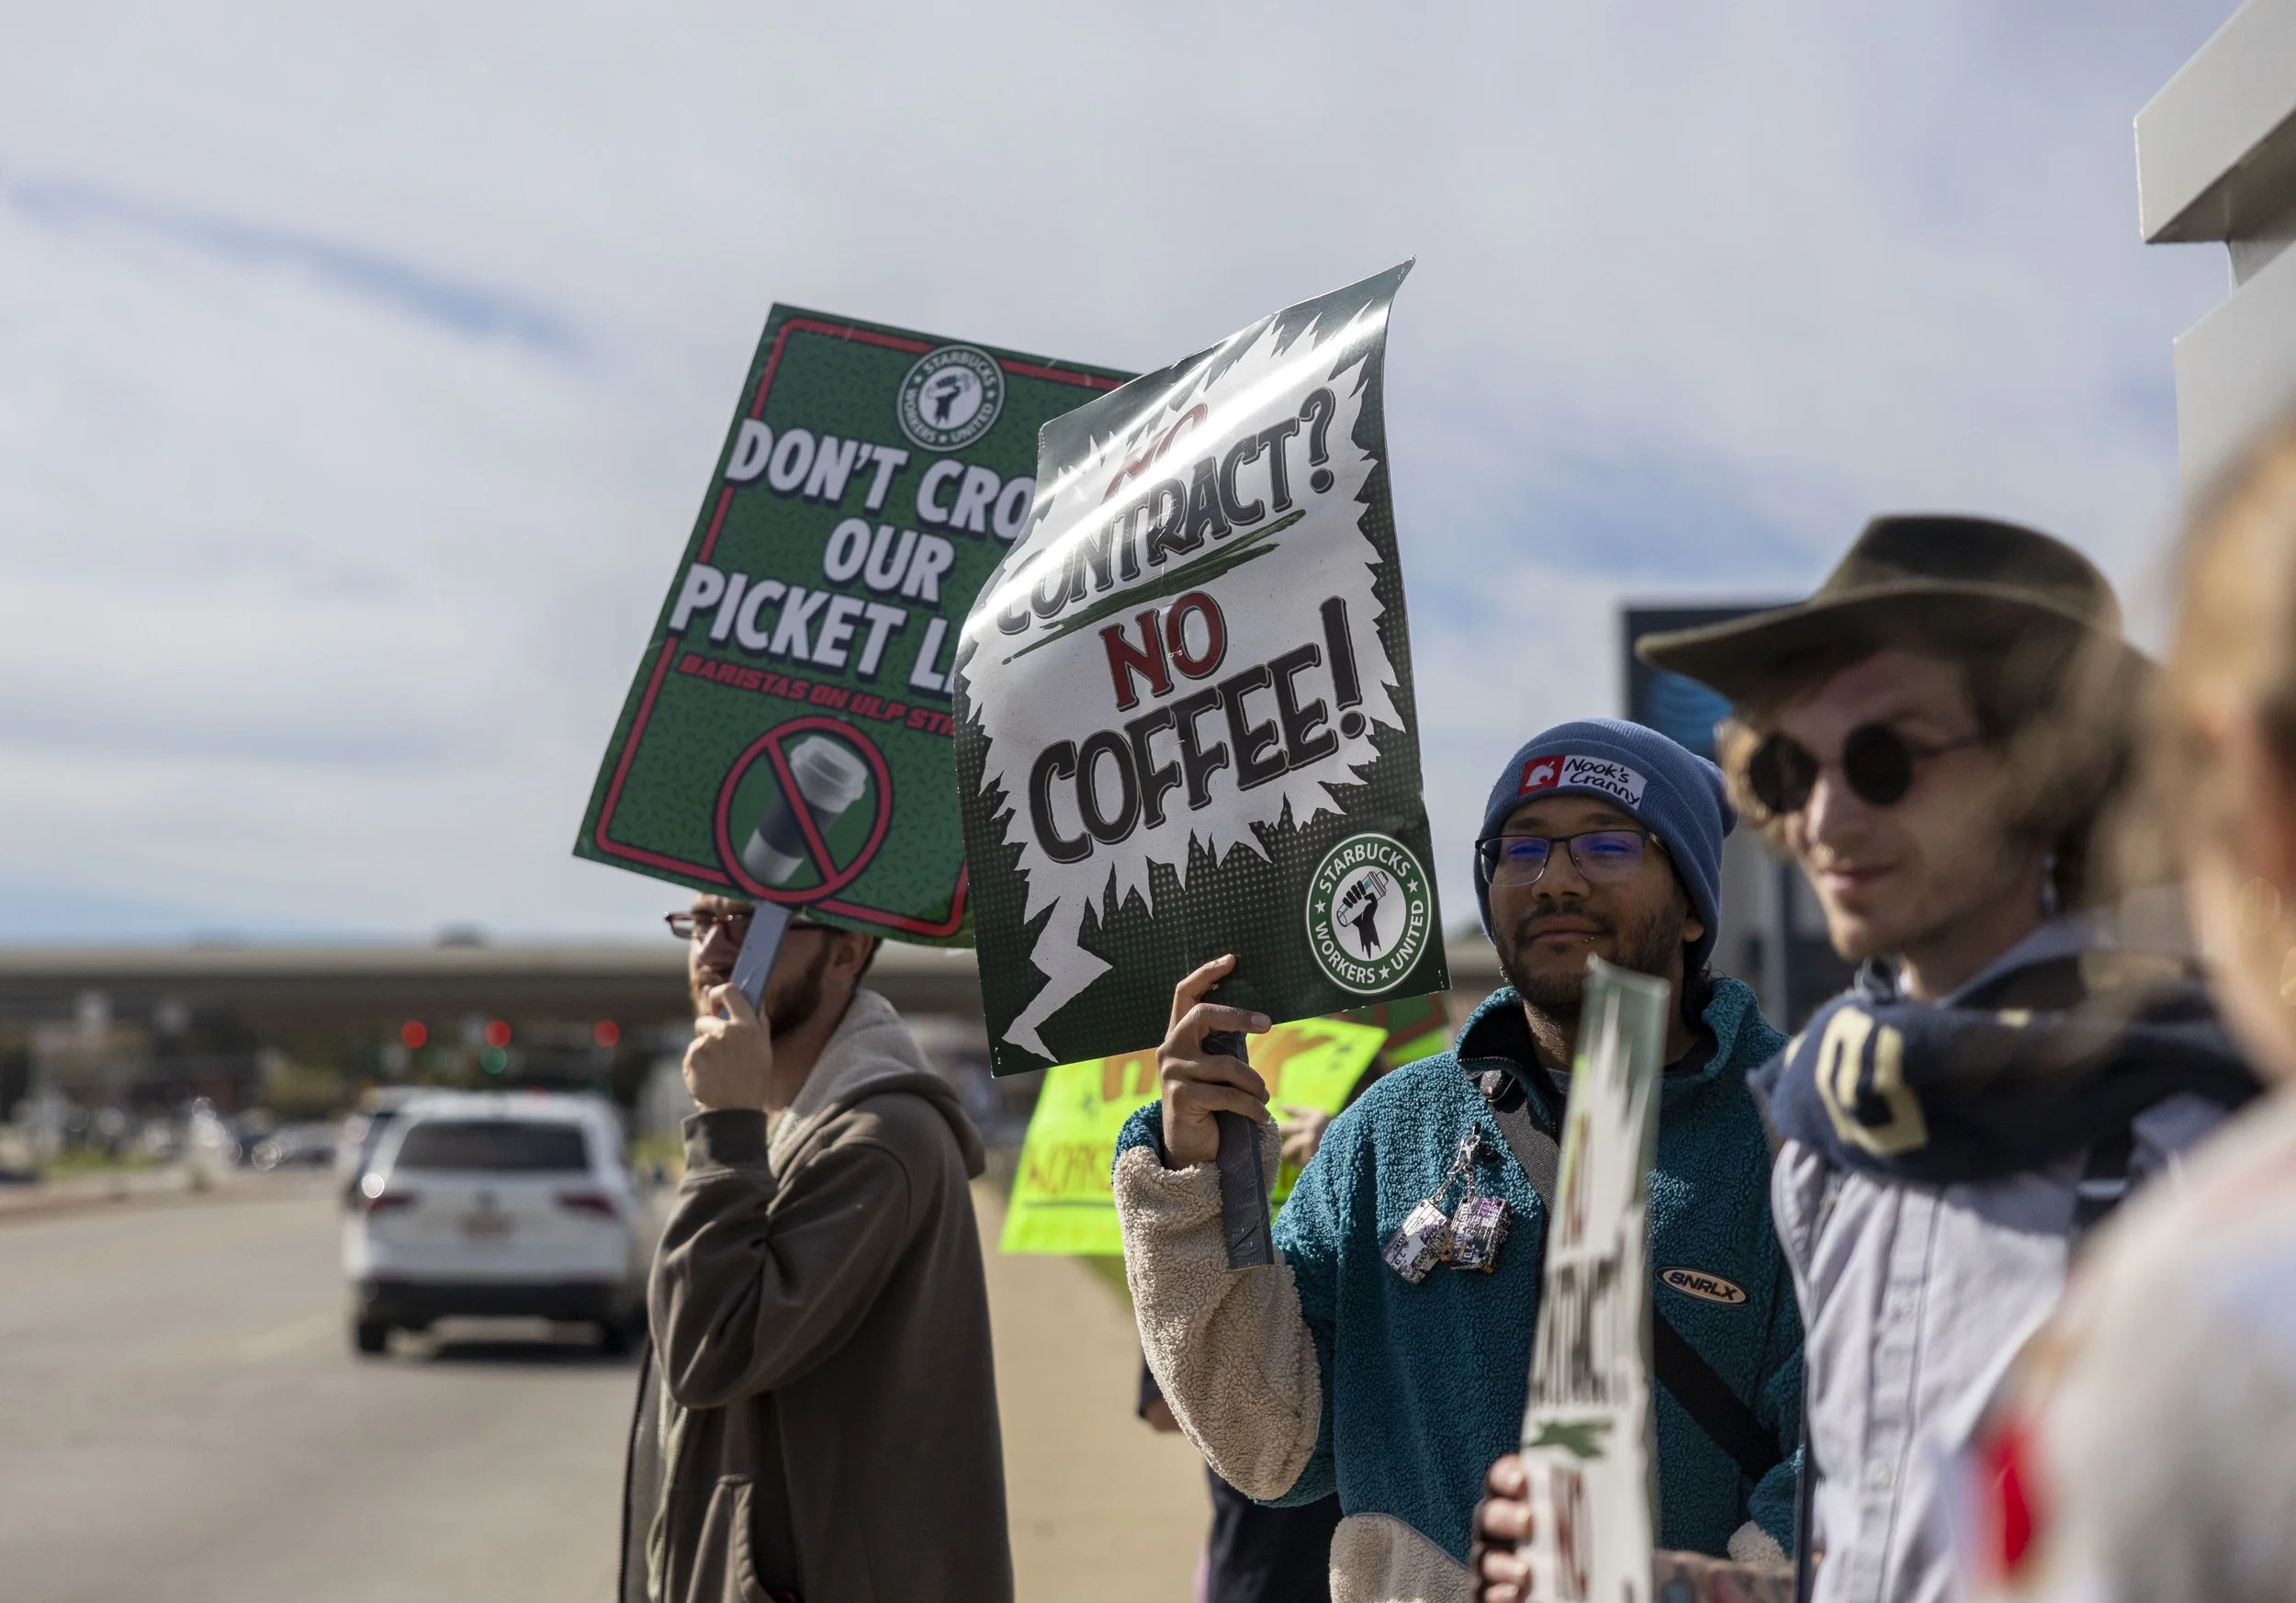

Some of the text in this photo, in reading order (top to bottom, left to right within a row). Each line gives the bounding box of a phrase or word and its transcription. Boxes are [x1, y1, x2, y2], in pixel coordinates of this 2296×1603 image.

[922, 351, 997, 387] STARBUCKS
[903, 388, 994, 443] WORKERS UNITED
[726, 417, 909, 511] DON'T
[995, 386, 1336, 636] CONTRACT?
[823, 517, 956, 603] OUR
[669, 562, 956, 695] PICKET L
[1098, 591, 1228, 712] NO
[678, 650, 810, 699] BARISTAS
[808, 683, 851, 710] ON
[849, 692, 907, 721] ULP
[1028, 595, 1367, 864] COFFEE!
[1564, 758, 1630, 784] Nook's
[1569, 771, 1640, 806] Cranny
[1319, 842, 1412, 895] STARBUCKS
[1314, 899, 1424, 985] WORKERS UNITED
